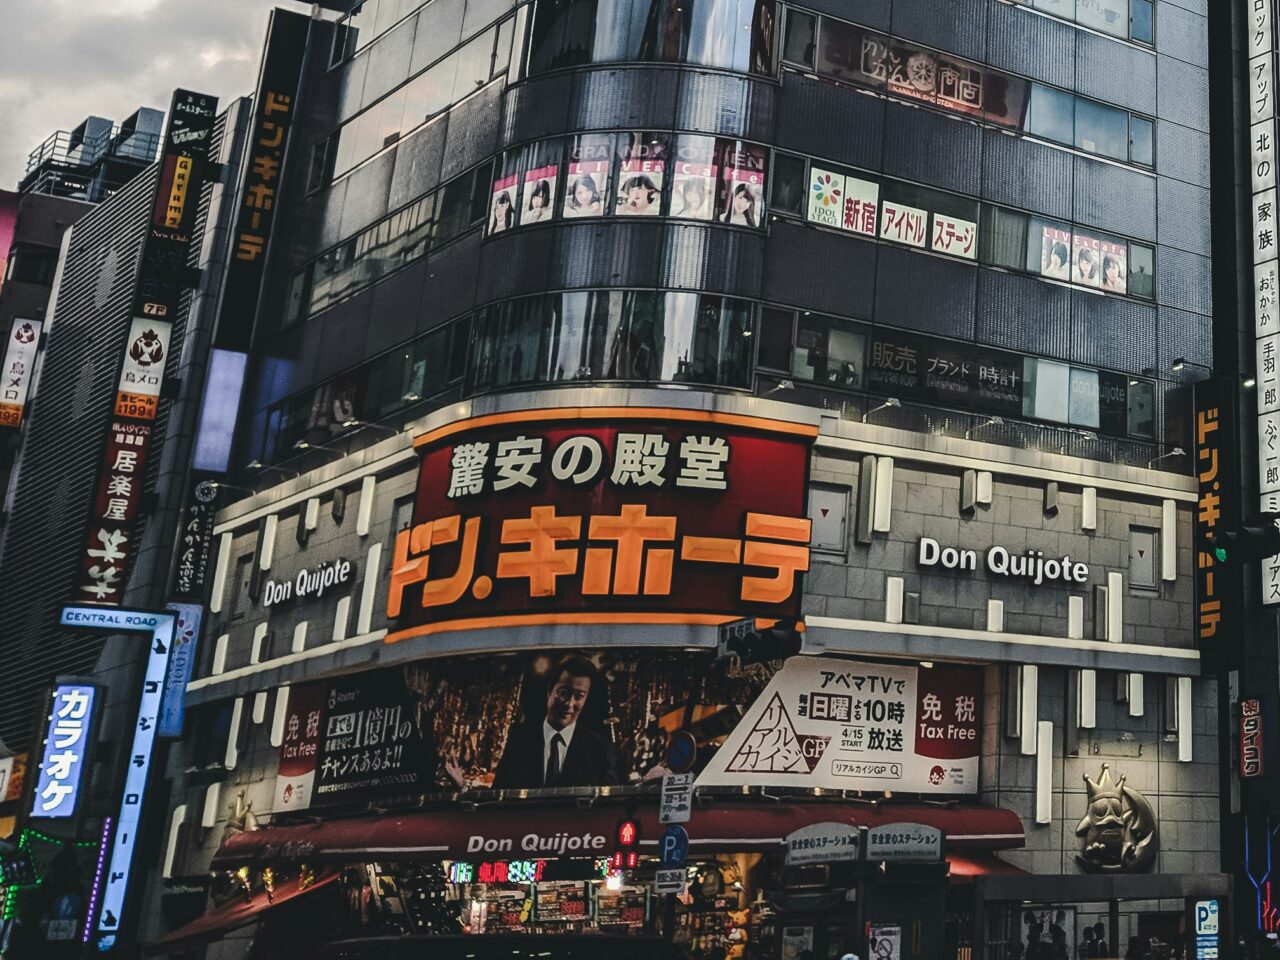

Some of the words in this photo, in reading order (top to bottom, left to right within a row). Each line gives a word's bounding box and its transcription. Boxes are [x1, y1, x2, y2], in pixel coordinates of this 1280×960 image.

[811, 213, 838, 226] STAGE
[814, 205, 836, 217] IDOL
[844, 197, 877, 235] 新宿
[884, 206, 925, 244] アイドル
[934, 220, 975, 256] ステージ
[146, 305, 165, 316] 7F
[979, 366, 1019, 388] 時計
[447, 435, 732, 499] 驚安の殿堂
[919, 537, 977, 570] Don
[987, 546, 1089, 585] Quijote
[264, 581, 292, 607] Don
[295, 559, 351, 597] Quijote
[66, 611, 122, 624] CENTRAL
[125, 616, 157, 627] ROAD
[820, 671, 905, 695] アベマTVで
[811, 696, 850, 720] 日曜
[864, 699, 905, 725] 10時
[921, 693, 975, 722] 免税
[867, 728, 903, 752] 放送
[920, 724, 944, 739] Tax
[948, 724, 976, 740] Free
[42, 689, 90, 811] カラオケ
[283, 744, 297, 758] Tax
[299, 742, 317, 756] Free
[836, 764, 886, 775] リアルカイジGP
[467, 835, 512, 853] Don
[522, 833, 606, 855] Quijote
